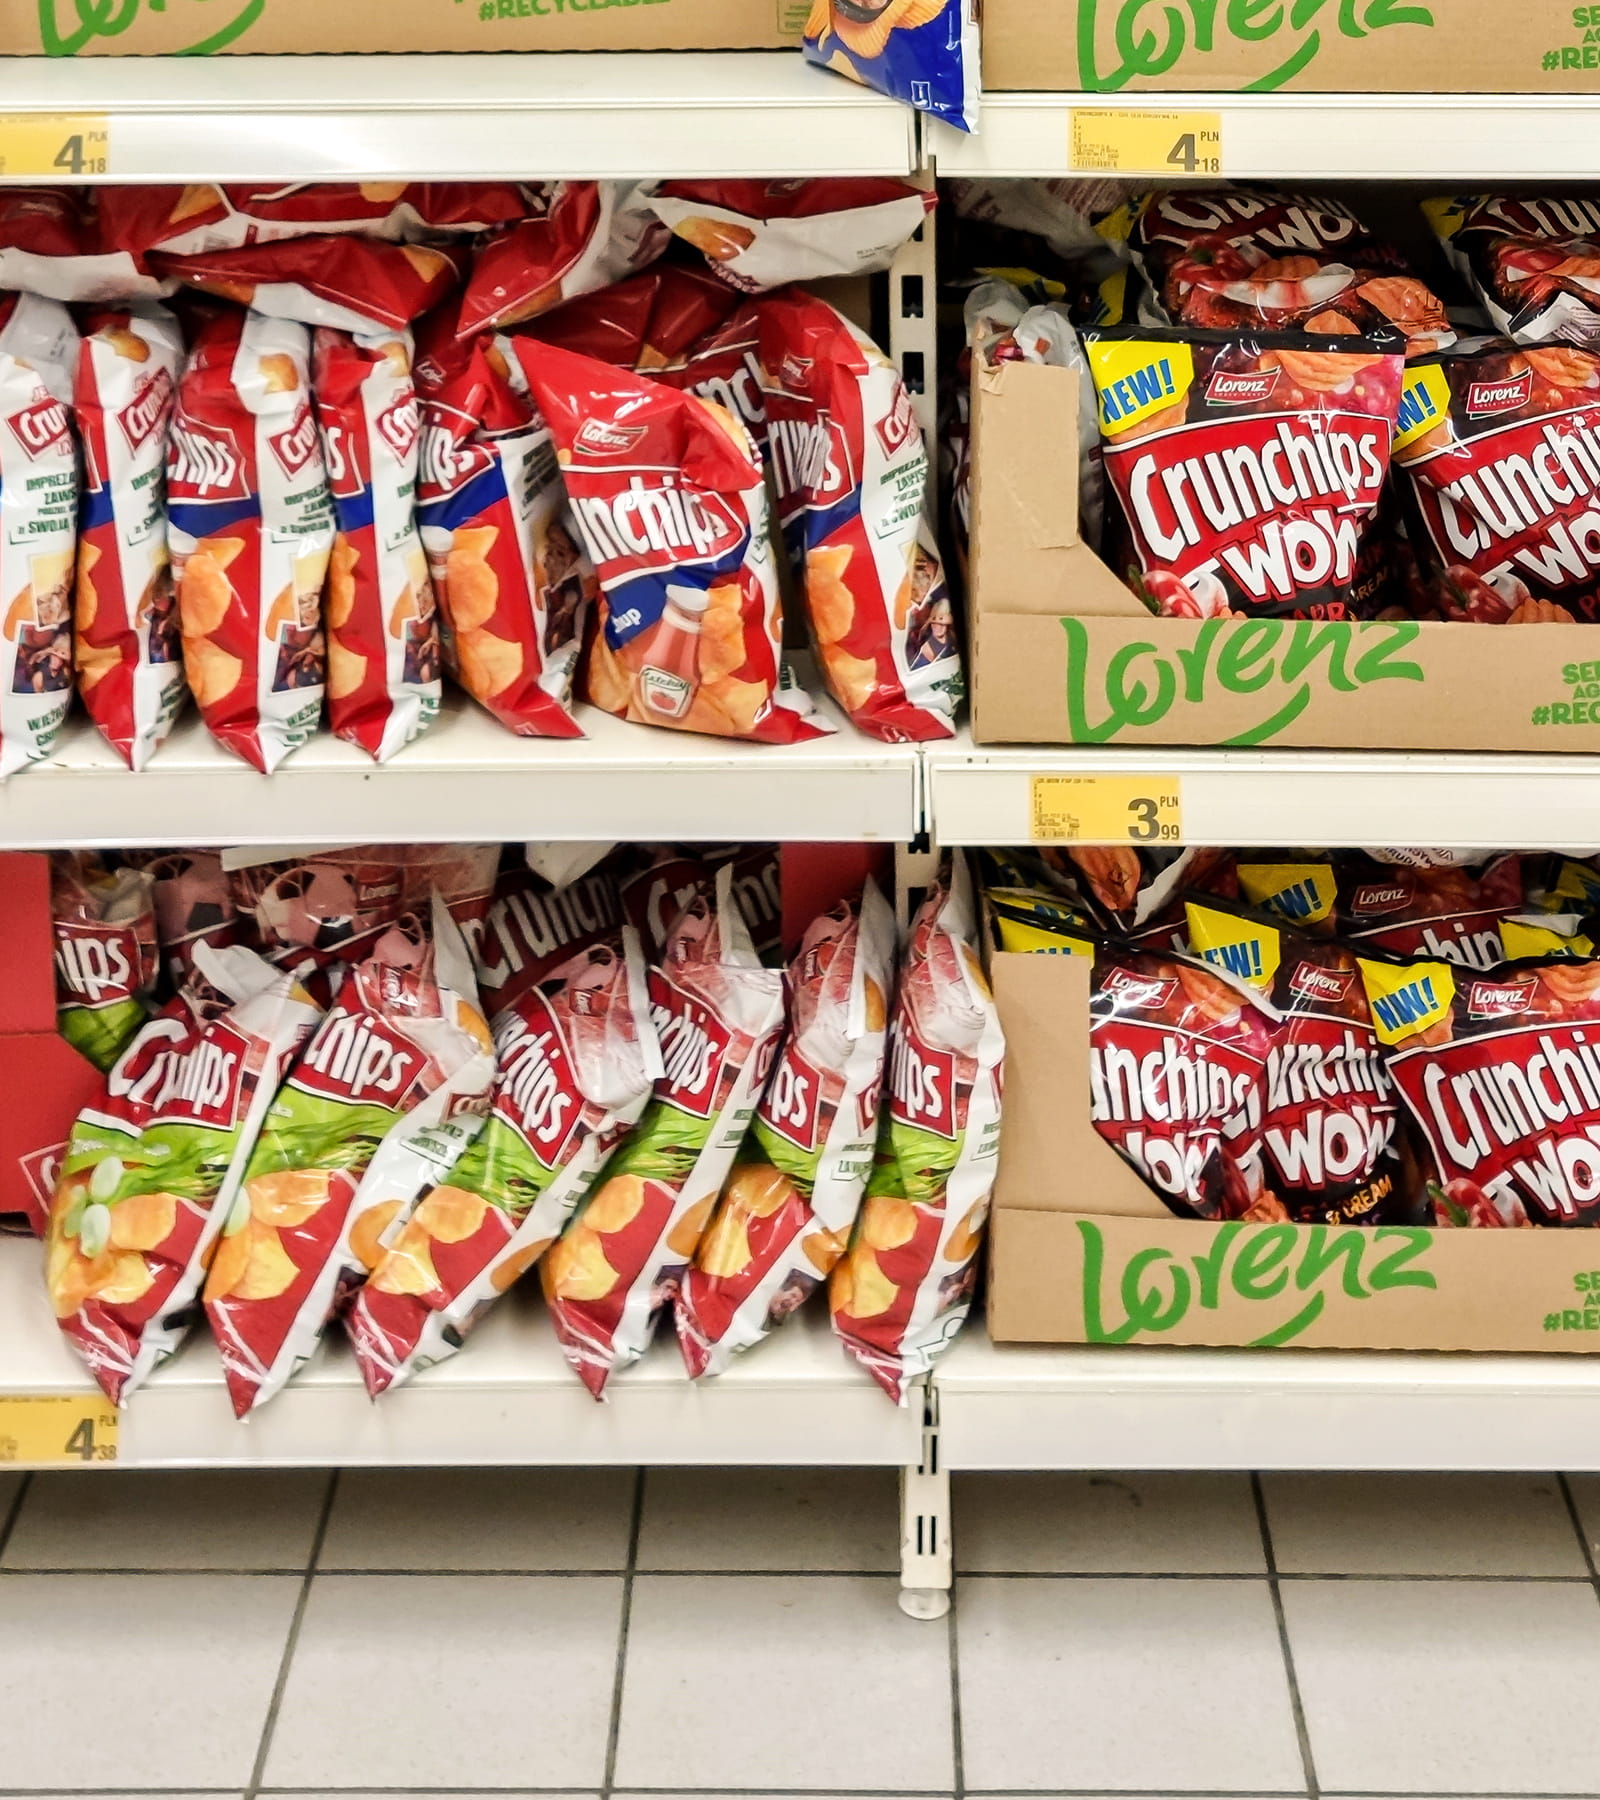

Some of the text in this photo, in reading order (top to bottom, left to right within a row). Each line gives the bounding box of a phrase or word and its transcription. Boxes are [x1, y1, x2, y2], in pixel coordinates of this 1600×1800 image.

[52, 134, 85, 174] 4
[88, 158, 106, 173] 18
[1166, 130, 1219, 171] 4 PLN
[1201, 158, 1220, 172] 18
[1101, 357, 1176, 425] NEW!
[1212, 375, 1267, 394] Lorenz
[1471, 383, 1524, 403] Lorenz
[1129, 419, 1381, 564] Crunchips
[1061, 617, 1425, 746] Lorenz
[1127, 795, 1179, 840] 3 PLN
[1161, 824, 1180, 840] 99
[1475, 987, 1525, 1005] Lorenz
[1076, 1221, 1437, 1347] Lorenz
[65, 1418, 97, 1461] 4
